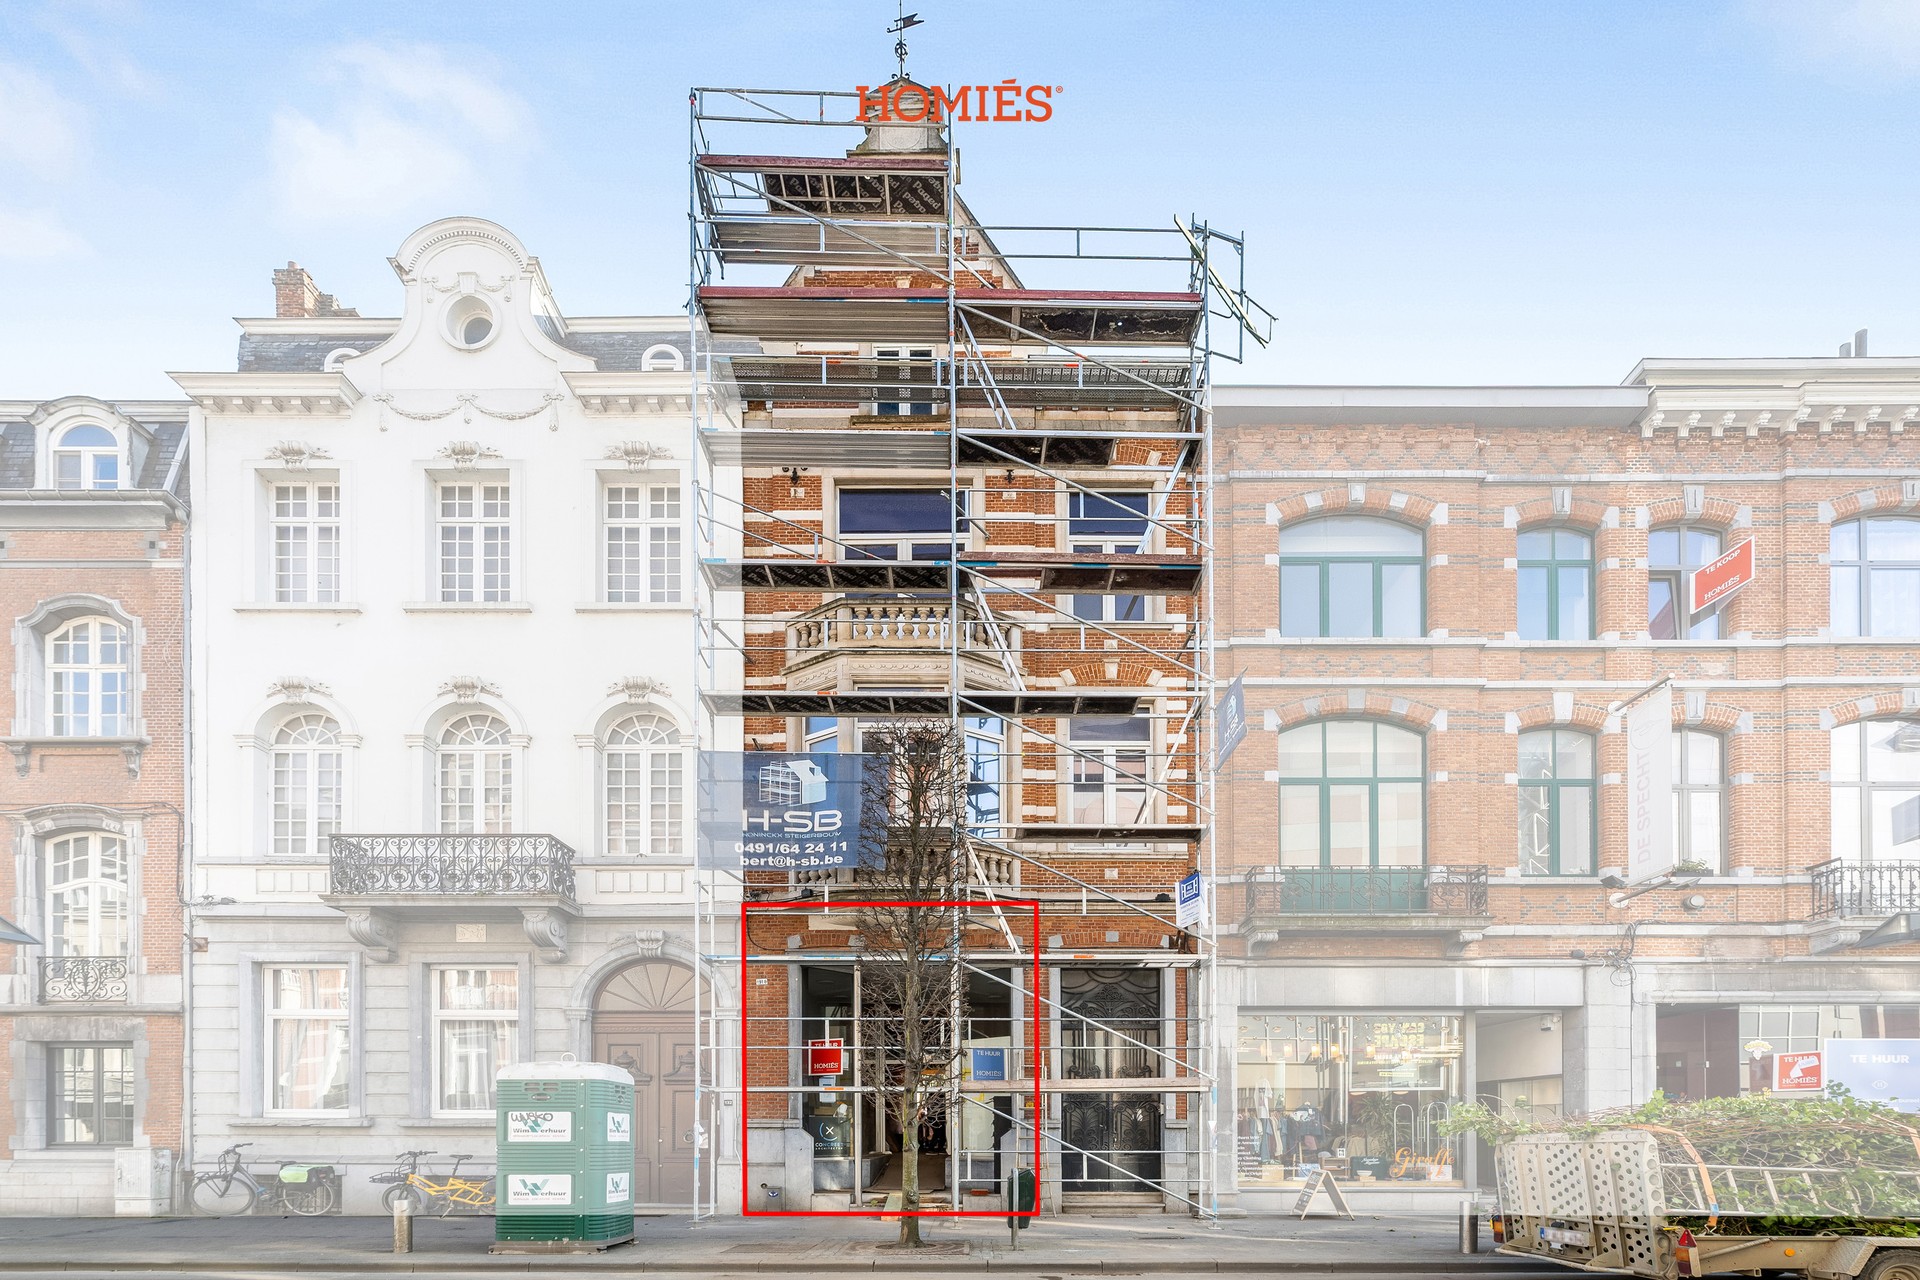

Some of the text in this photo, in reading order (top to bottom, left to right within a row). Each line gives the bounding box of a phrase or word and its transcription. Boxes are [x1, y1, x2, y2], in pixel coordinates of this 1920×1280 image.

[1705, 549, 1741, 574] TE KOOP
[1637, 753, 1650, 866] DE SPECHT
[741, 809, 842, 832] H-SB
[784, 831, 842, 839] STEIGERBOUW
[734, 841, 848, 854] 0491/64 24 11
[739, 854, 844, 867] bert@h-sb.be
[1850, 1054, 1910, 1064] TE HUUR
[1389, 1146, 1455, 1178] Giraffe
